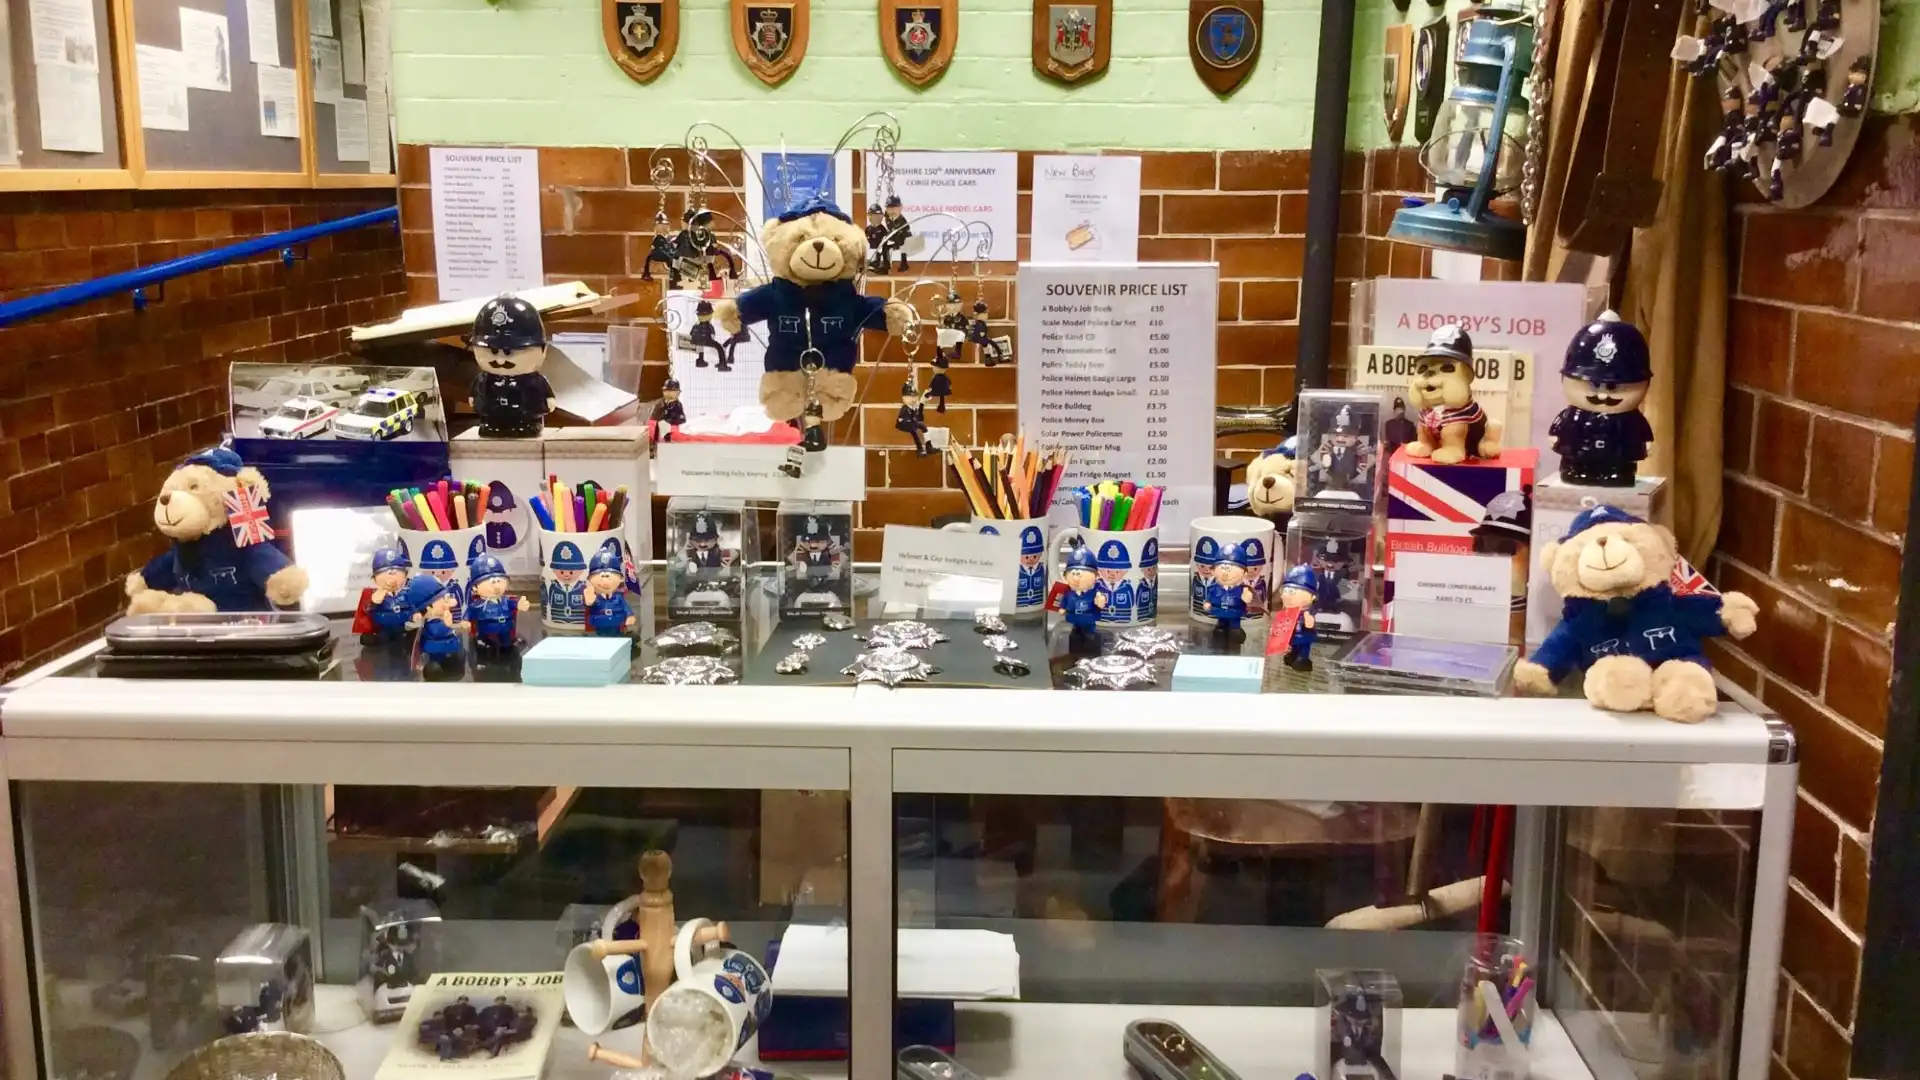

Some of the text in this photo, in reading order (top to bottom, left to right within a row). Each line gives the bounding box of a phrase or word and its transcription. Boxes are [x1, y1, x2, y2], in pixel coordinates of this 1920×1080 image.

[485, 155, 506, 164] PRICE
[507, 156, 523, 165] LIST
[944, 168, 996, 176] ANNIVERSARY
[1046, 284, 1188, 296] SOUVENIR PRICE LIST
[1048, 305, 1078, 313] Bobby's
[1397, 312, 1546, 336] A BOBBY'S JOB
[1367, 353, 1378, 374] A
[1475, 357, 1500, 380] OB
[1041, 402, 1092, 411] Police Bulldog
[1041, 416, 1063, 424] Police
[1061, 430, 1084, 438] Power
[1085, 430, 1123, 438] Policeman
[1390, 540, 1468, 554] British Bulldog
[436, 974, 565, 987] A BOBBY'S JOB
